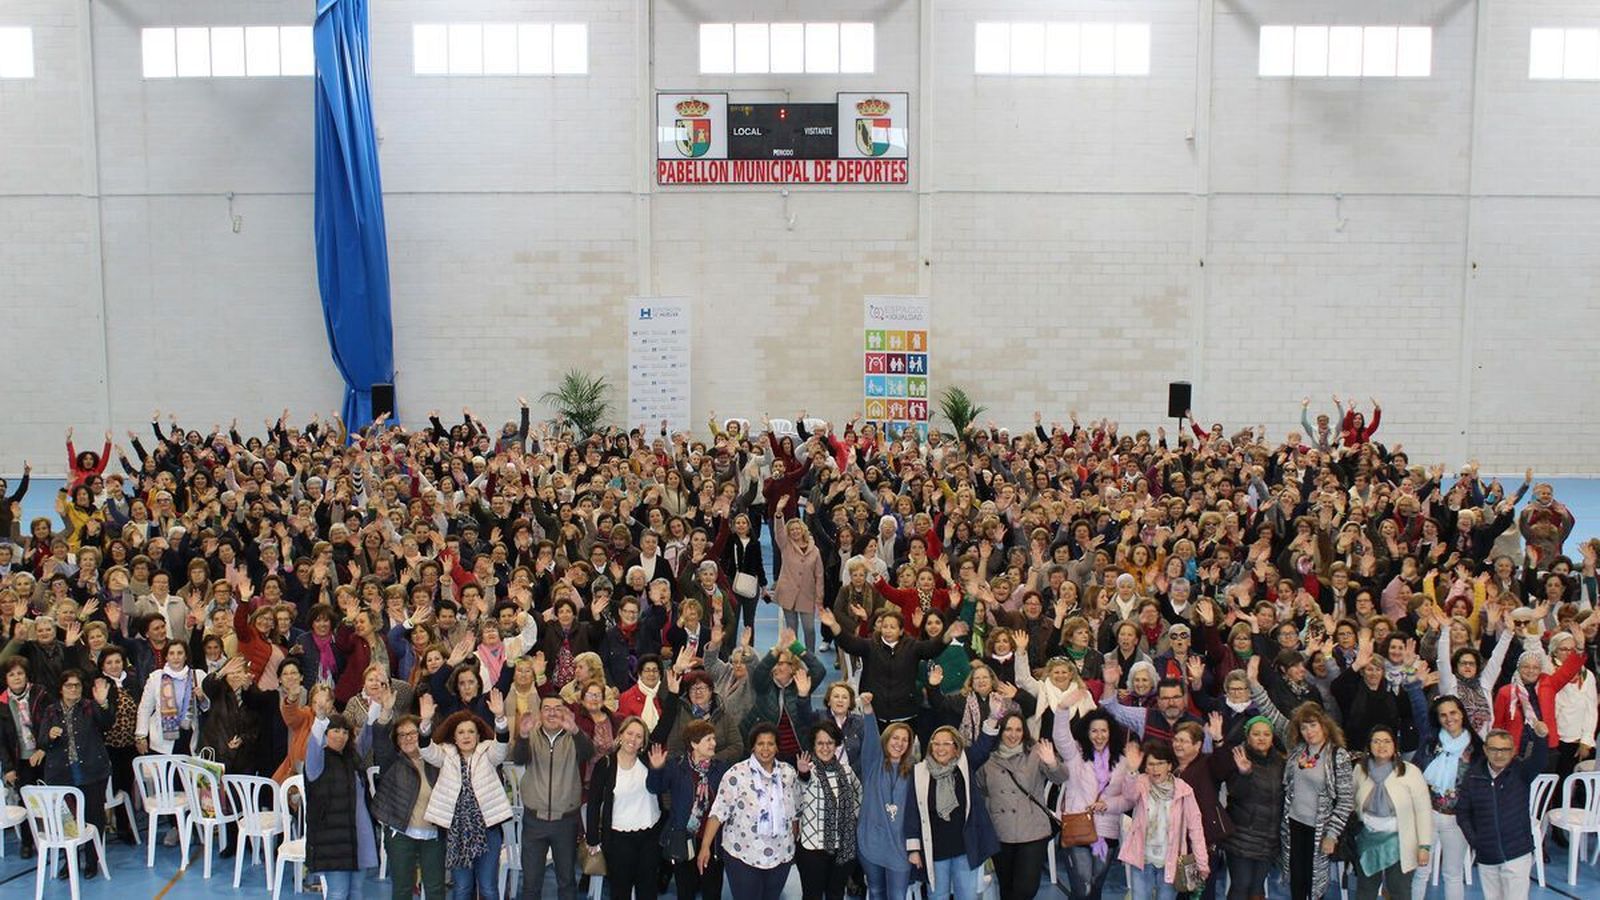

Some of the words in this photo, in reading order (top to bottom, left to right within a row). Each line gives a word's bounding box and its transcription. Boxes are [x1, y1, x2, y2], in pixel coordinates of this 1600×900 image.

[733, 128, 762, 136] LOCAL
[804, 127, 833, 136] VISITANTE
[658, 160, 728, 183] PABELLON
[733, 160, 810, 183] MUNICIPAL
[815, 160, 832, 182] DE
[836, 160, 907, 182] DEPORTES
